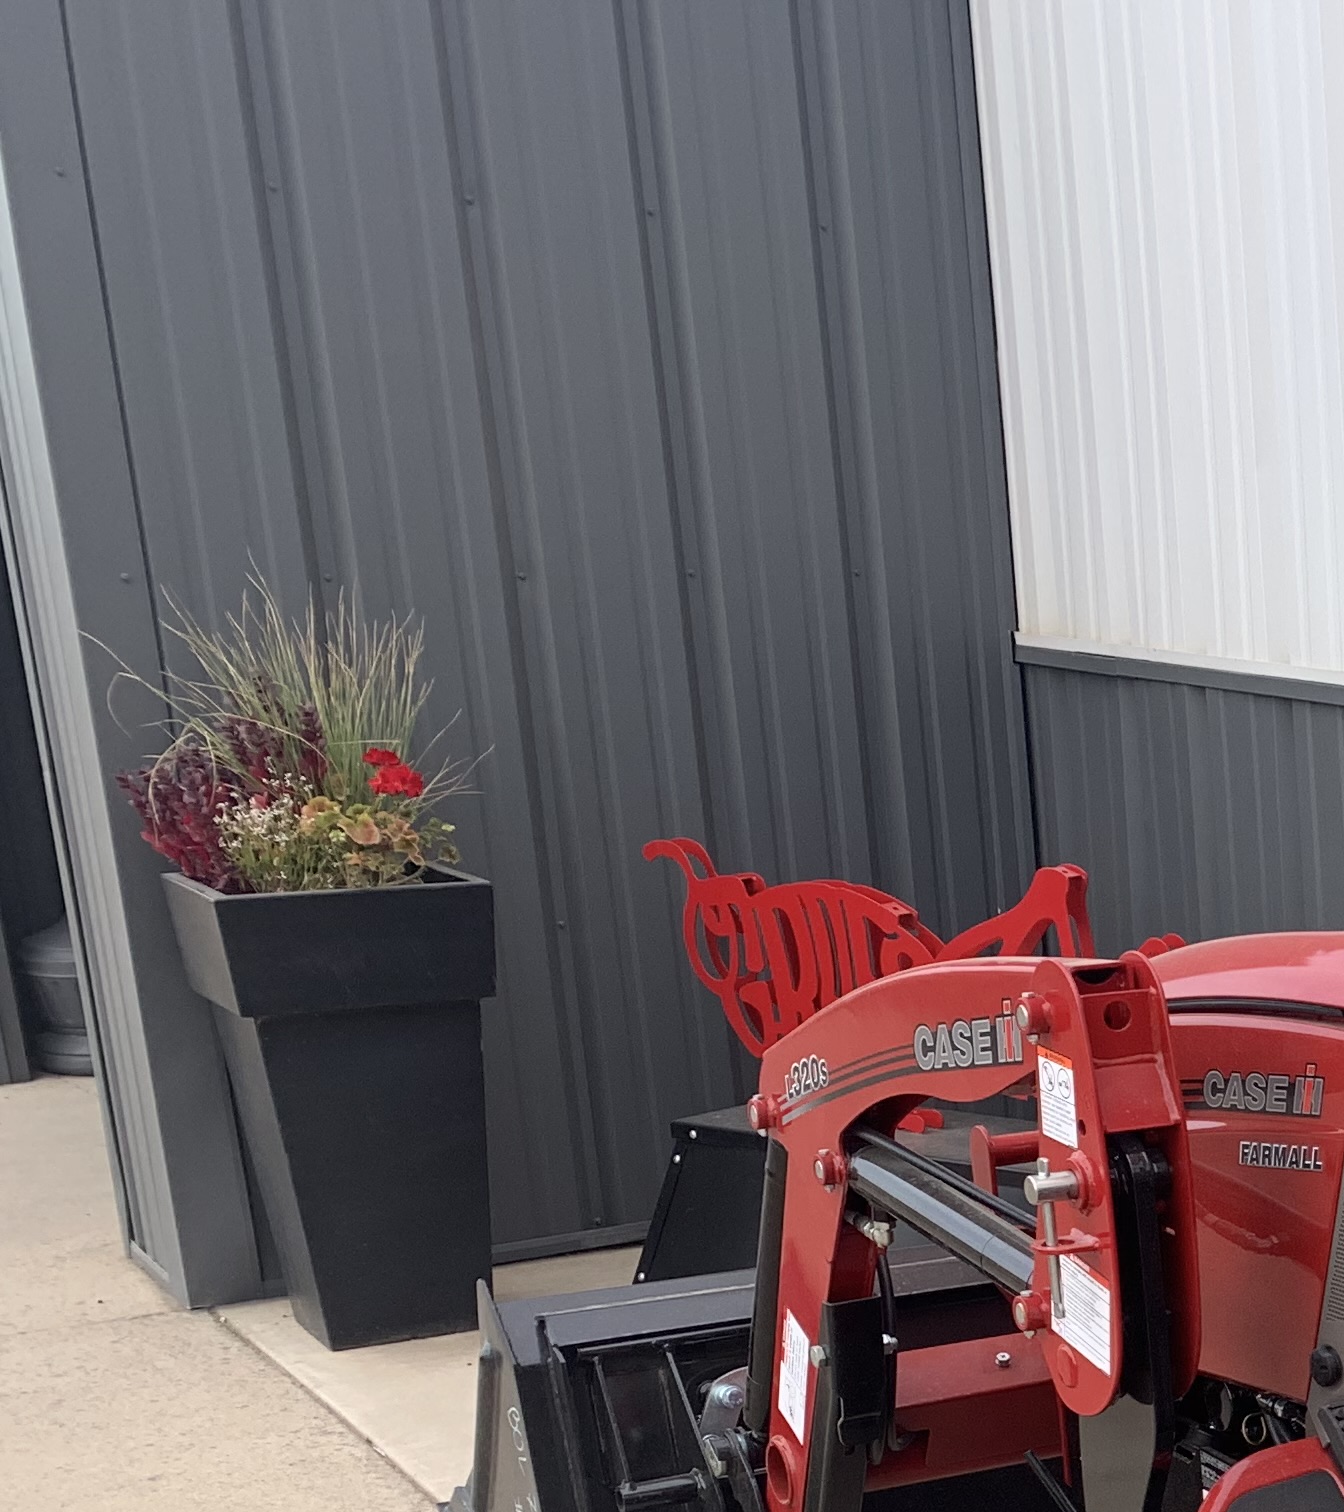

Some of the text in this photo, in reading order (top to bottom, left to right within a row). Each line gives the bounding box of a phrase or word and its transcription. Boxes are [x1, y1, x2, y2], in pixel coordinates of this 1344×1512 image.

[914, 1014, 993, 1071] CASE
[784, 1053, 829, 1101] L320s
[1203, 1069, 1290, 1114] CASE
[1239, 1140, 1323, 1171] FARMALL
